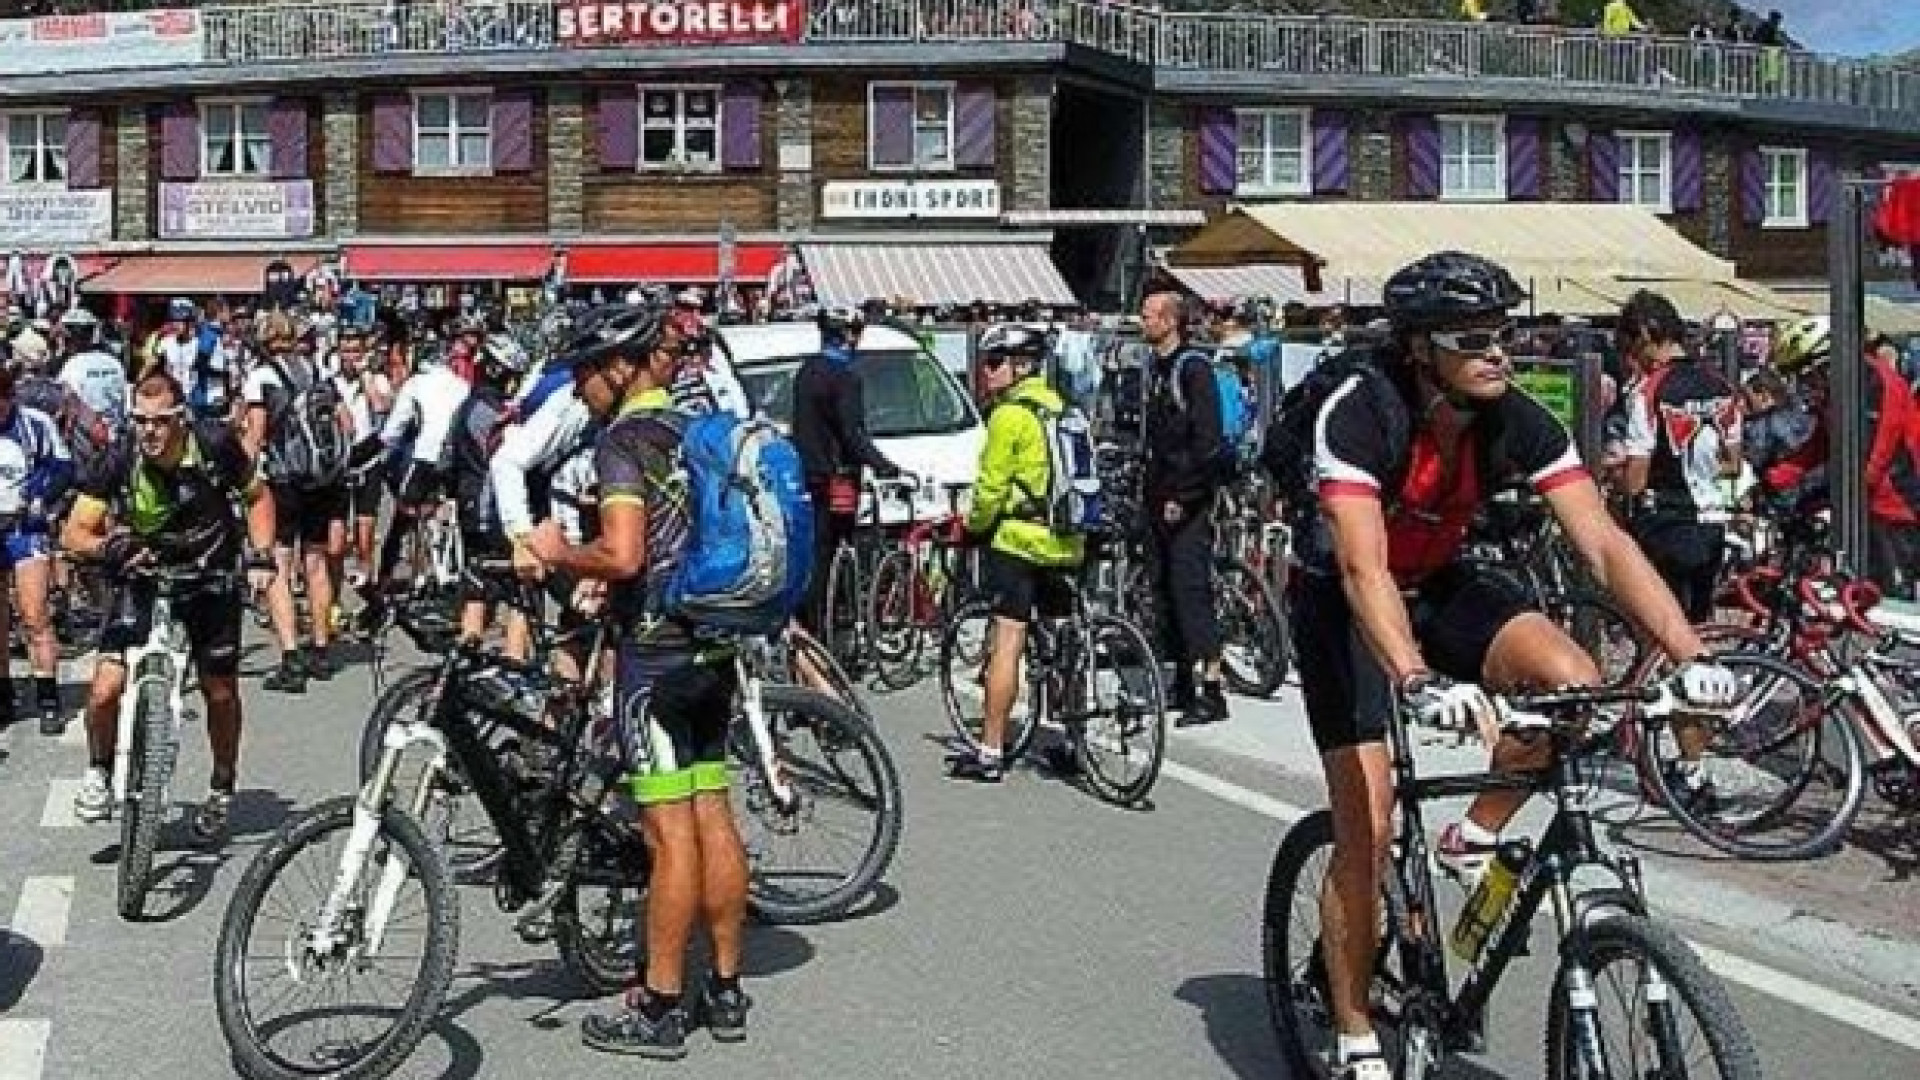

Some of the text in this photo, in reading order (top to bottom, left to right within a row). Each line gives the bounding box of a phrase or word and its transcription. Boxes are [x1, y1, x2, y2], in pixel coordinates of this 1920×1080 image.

[557, 2, 788, 37] SERTORELLI
[188, 200, 283, 215] STELVIO
[925, 188, 996, 209] SPORT
